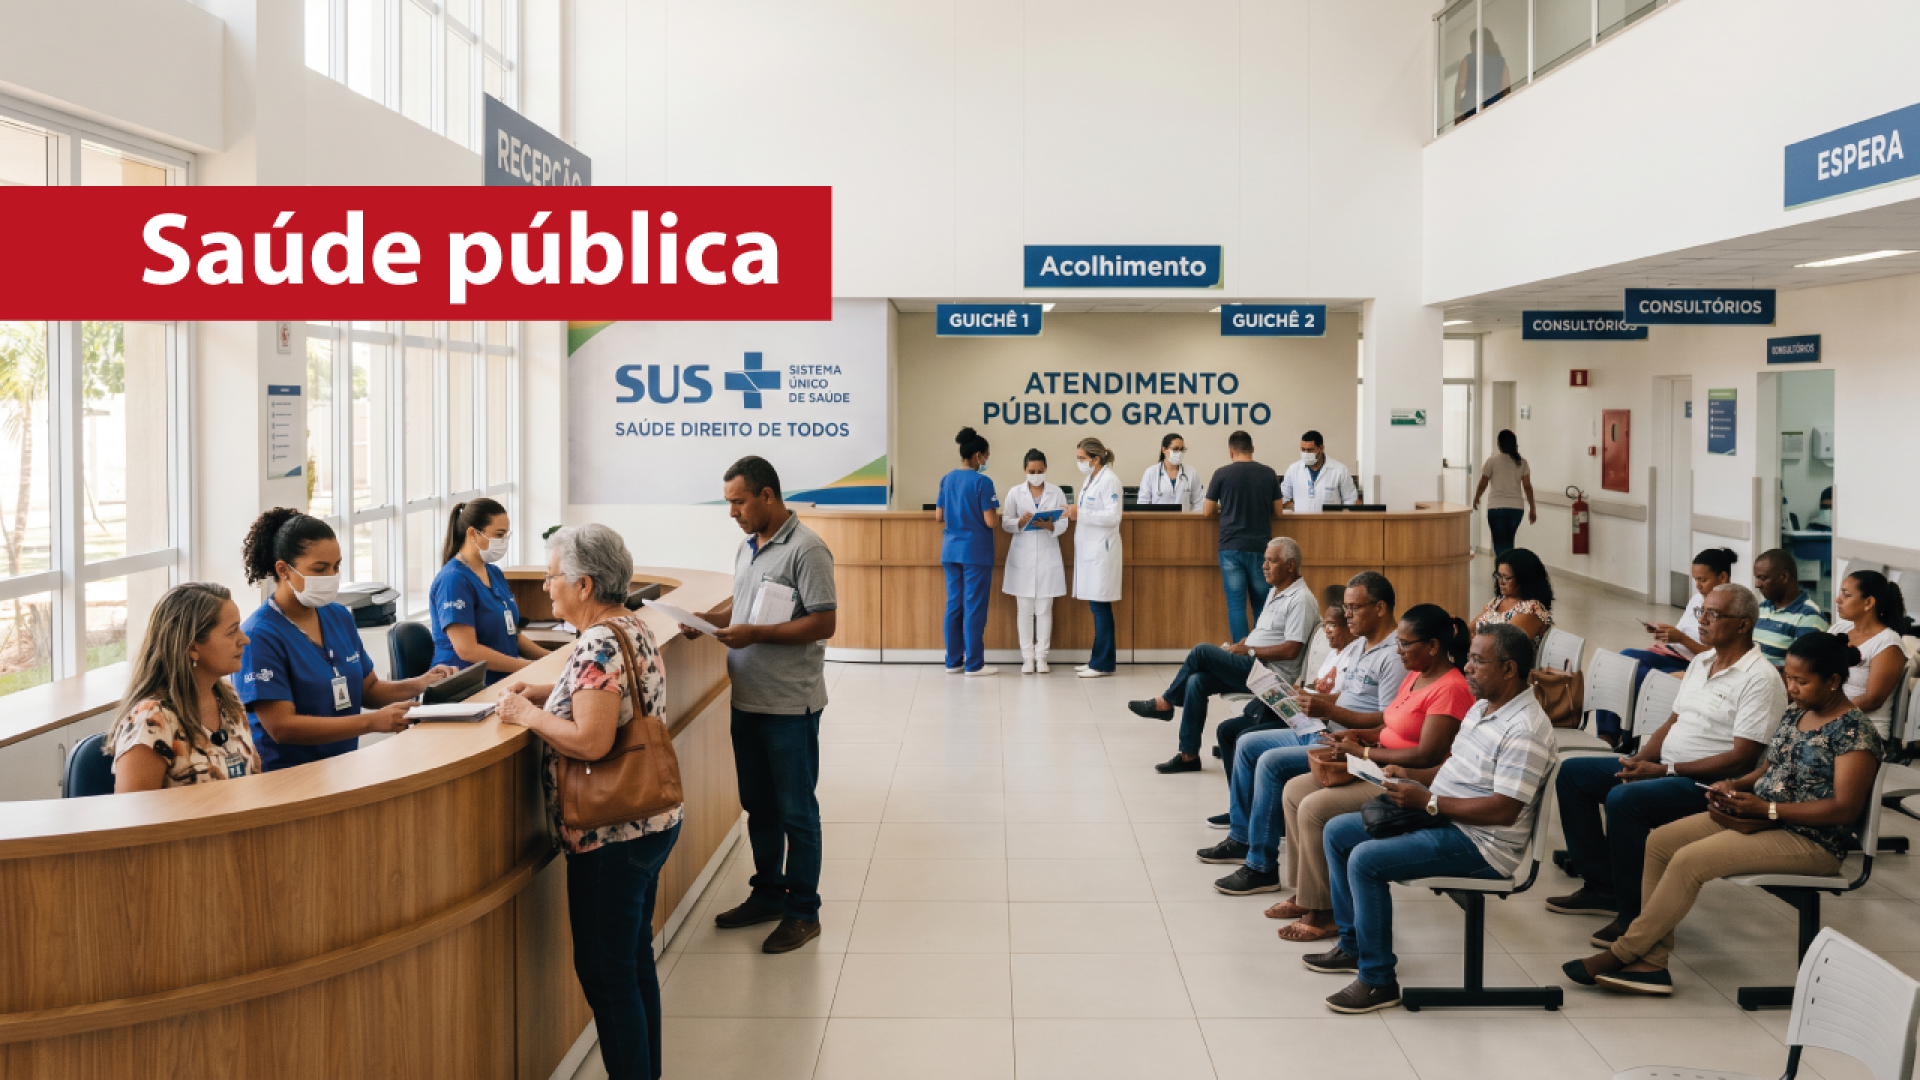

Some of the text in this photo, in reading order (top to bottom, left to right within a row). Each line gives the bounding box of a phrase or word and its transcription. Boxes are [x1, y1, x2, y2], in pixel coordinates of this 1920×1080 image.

[1817, 129, 1904, 181] ESPERA
[1040, 254, 1207, 277] Acolhimento
[1638, 297, 1762, 315] CONSULTÓRIOS
[949, 309, 1029, 328] GUICHÊ 1
[1232, 309, 1315, 328] GUICHÊ 2
[788, 364, 842, 376] SISTEMA
[615, 364, 713, 405] SUS
[788, 376, 829, 389] ÚNICO
[1024, 371, 1240, 395] ATENDIMENTO
[788, 390, 850, 403] DE SAÚDE
[983, 396, 1272, 426] PÚBLICO GRATUITO
[615, 418, 850, 437] SAÚDE DIREITO DE TODOS
